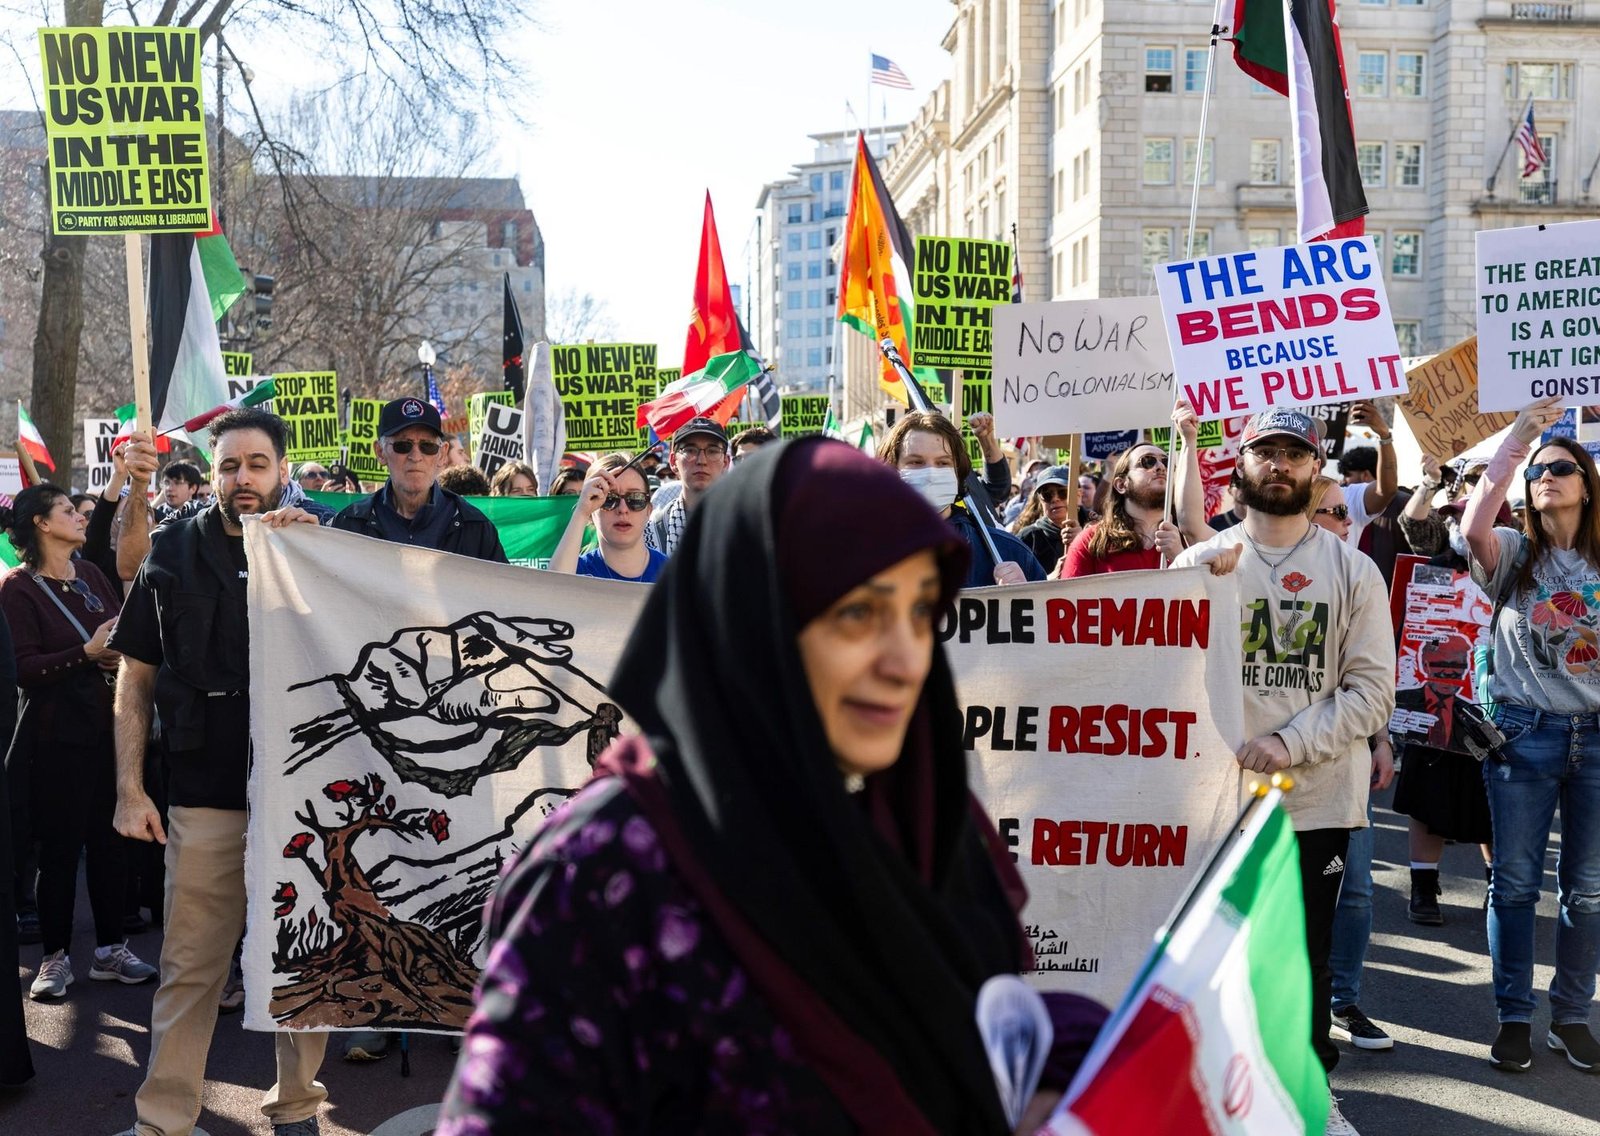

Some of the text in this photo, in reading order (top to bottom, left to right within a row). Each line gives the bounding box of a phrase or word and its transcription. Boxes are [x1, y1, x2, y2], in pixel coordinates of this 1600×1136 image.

[44, 32, 196, 85] NO NEW
[49, 87, 200, 125] US WAR
[54, 134, 203, 168] IN THE
[56, 168, 204, 207] MIDDLE EAST
[78, 215, 102, 227] PARTY
[104, 215, 119, 227] FOR
[119, 214, 157, 227] SOCIALISM
[158, 214, 164, 226] &
[166, 212, 207, 225] LIBERATION
[918, 239, 950, 273] NO
[957, 241, 1010, 277] NEW
[1167, 240, 1371, 304] THE ARC
[1485, 263, 1526, 285] THE
[917, 274, 1010, 302] US WAR
[916, 304, 946, 325] IN
[1482, 293, 1508, 314] TO
[1176, 288, 1381, 346] BENDS
[915, 327, 969, 351] MIDDLE
[1075, 315, 1148, 353] WAR
[1512, 321, 1531, 341] IS
[1540, 320, 1554, 339] A
[553, 346, 631, 375] NO NEW
[633, 345, 656, 364] EW
[926, 356, 940, 364] PARTY
[941, 356, 950, 364] FOR
[951, 357, 976, 365] SOCIALISM
[1226, 335, 1338, 371] BECAUSE
[1508, 348, 1563, 370] THAT
[222, 355, 249, 376] EW
[635, 367, 656, 380] AR
[275, 376, 334, 396] STOP THE
[555, 374, 634, 396] US WAR
[636, 385, 655, 397] HE
[1044, 370, 1174, 398] COLONIALISM
[1184, 355, 1401, 416] WE PULL IT
[1423, 358, 1464, 404] HEY
[930, 386, 943, 402] THE
[276, 397, 336, 416] WAR
[353, 401, 374, 422] NO
[563, 399, 634, 417] N THE
[782, 398, 829, 415] NO NEW
[352, 423, 374, 438] US
[488, 406, 522, 439] U.
[606, 417, 635, 437] EAST
[783, 416, 799, 428] US
[287, 418, 339, 450] N IRAN!
[1092, 435, 1105, 443] NOT
[351, 442, 371, 455] IN
[350, 455, 385, 472] MIDDL
[941, 598, 1210, 649] OPLE REMAIN
[1241, 598, 1329, 669] AZA
[1242, 665, 1260, 686] HE
[964, 705, 1039, 752] PLE
[1031, 818, 1187, 867] RETURN
[1035, 941, 1068, 958] الشبا
